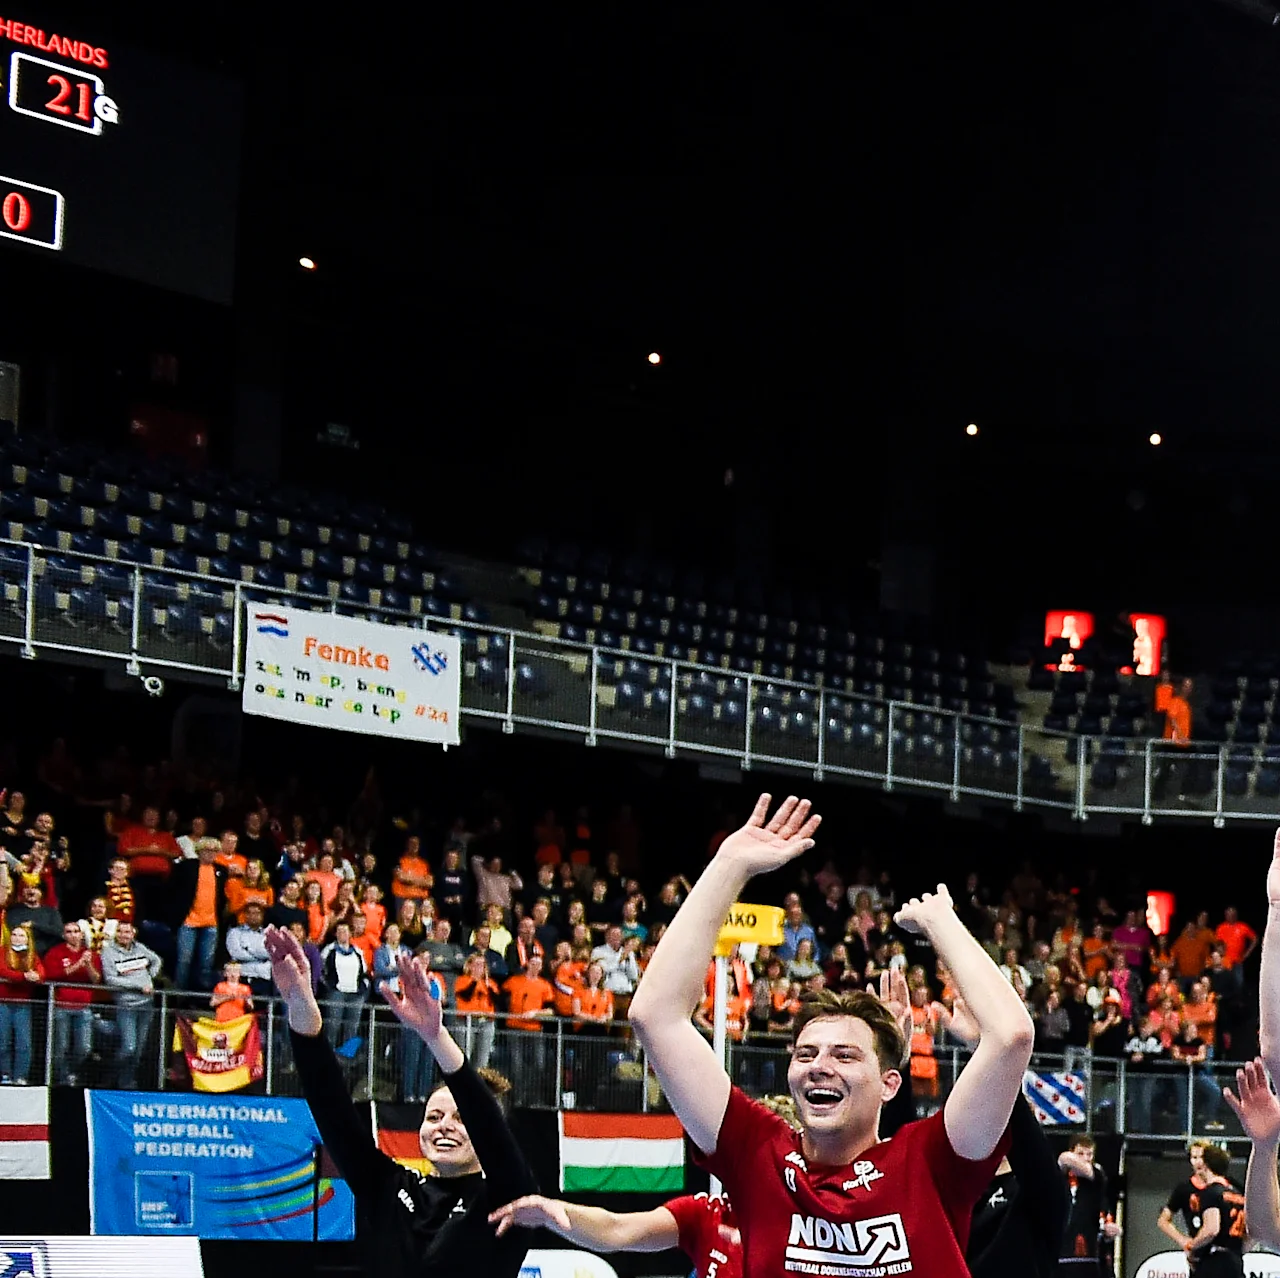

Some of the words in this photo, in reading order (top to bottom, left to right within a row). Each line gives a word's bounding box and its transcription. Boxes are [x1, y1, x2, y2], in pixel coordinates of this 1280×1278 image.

[45, 74, 92, 121] 21
[304, 636, 390, 672] Femke
[132, 1103, 287, 1123] INTERNATIONAL
[133, 1122, 233, 1140] KORFBALL
[134, 1141, 254, 1159] FEDERATION
[788, 1213, 858, 1252] NDN
